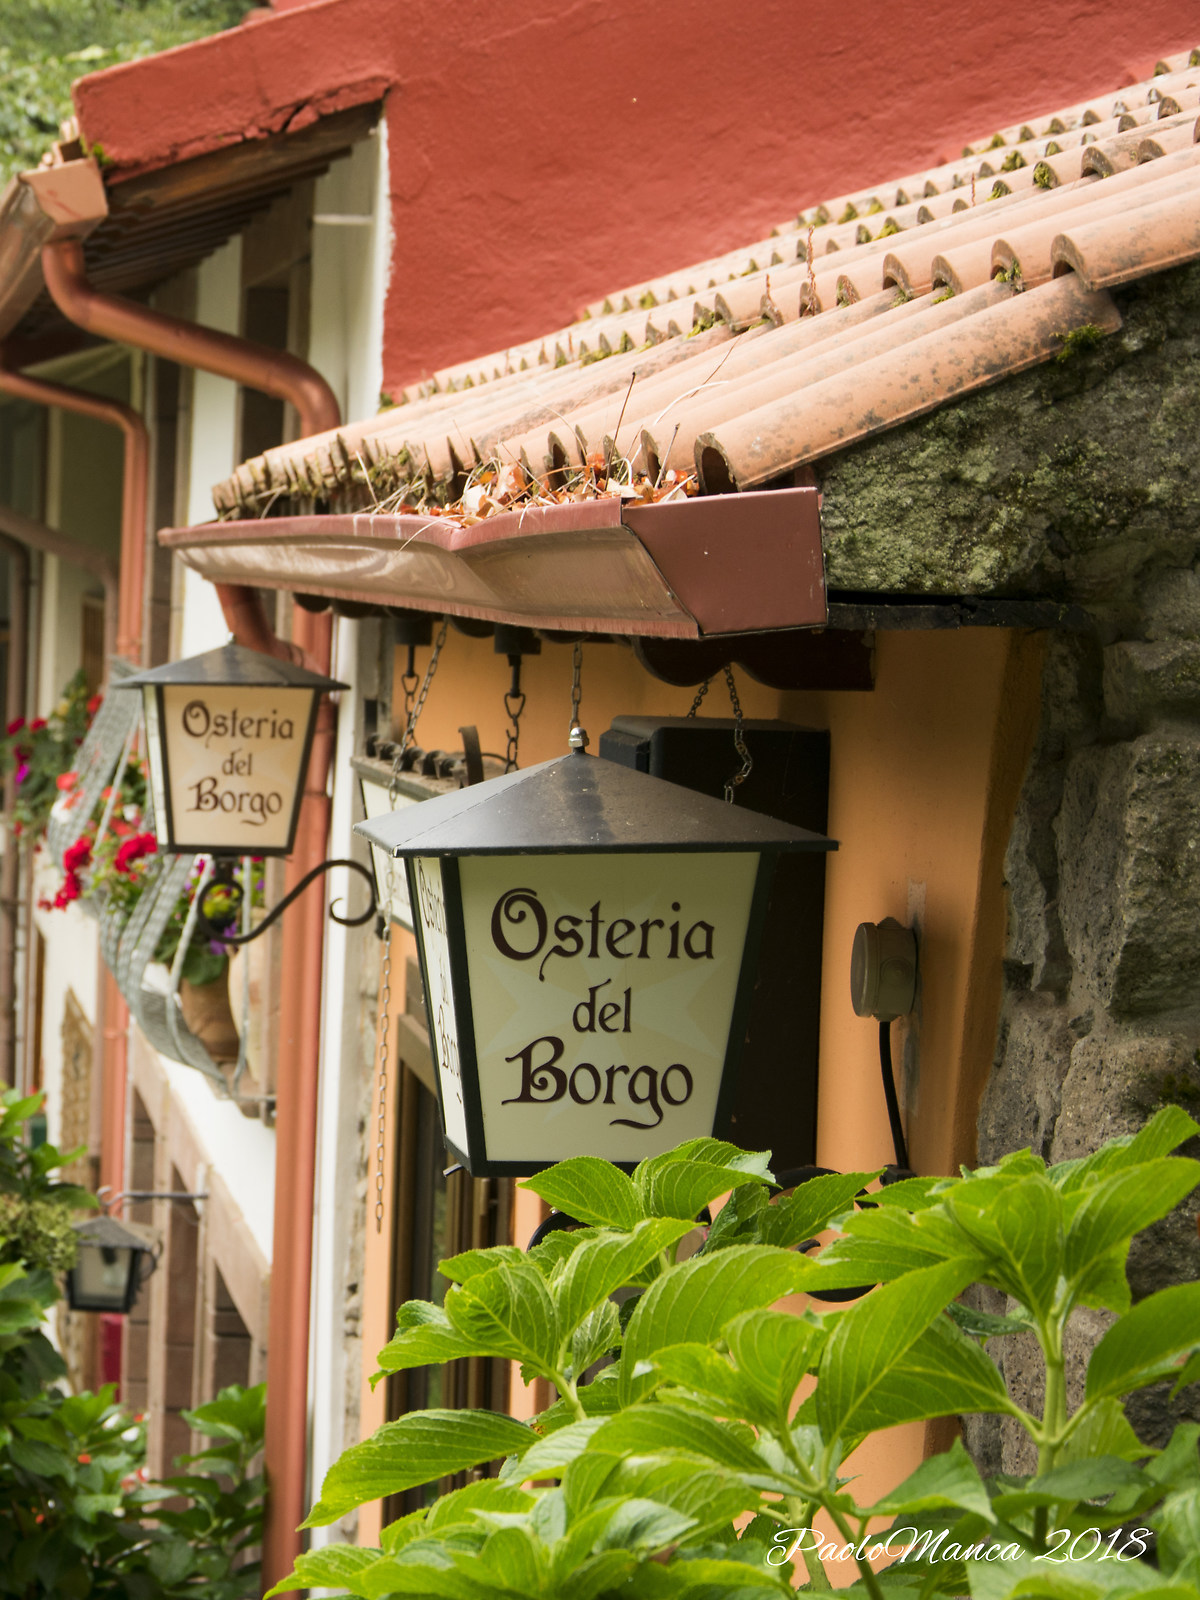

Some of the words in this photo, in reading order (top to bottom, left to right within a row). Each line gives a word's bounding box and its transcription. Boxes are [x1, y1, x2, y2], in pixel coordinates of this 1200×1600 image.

[182, 700, 294, 749] Osteria
[221, 747, 254, 777] del
[186, 774, 284, 826] Borgo
[490, 887, 716, 982] Osteria
[572, 978, 632, 1034] del
[501, 1035, 694, 1130] Borgo
